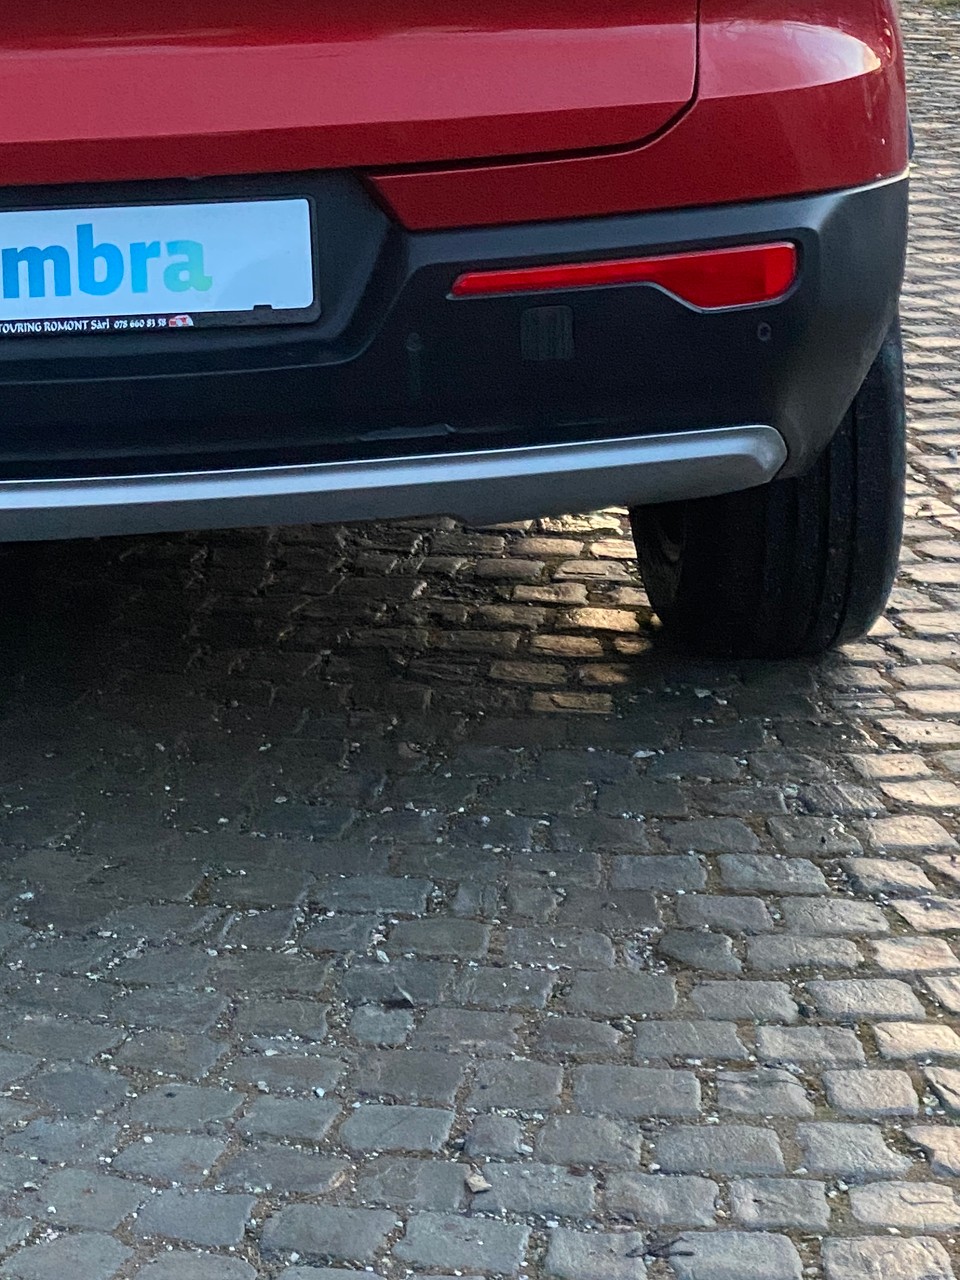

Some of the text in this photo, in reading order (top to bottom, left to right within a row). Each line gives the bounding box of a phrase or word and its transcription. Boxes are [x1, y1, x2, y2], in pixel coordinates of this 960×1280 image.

[43, 320, 89, 332] ROMONT
[113, 319, 128, 329] 078
[129, 318, 145, 328] 660
